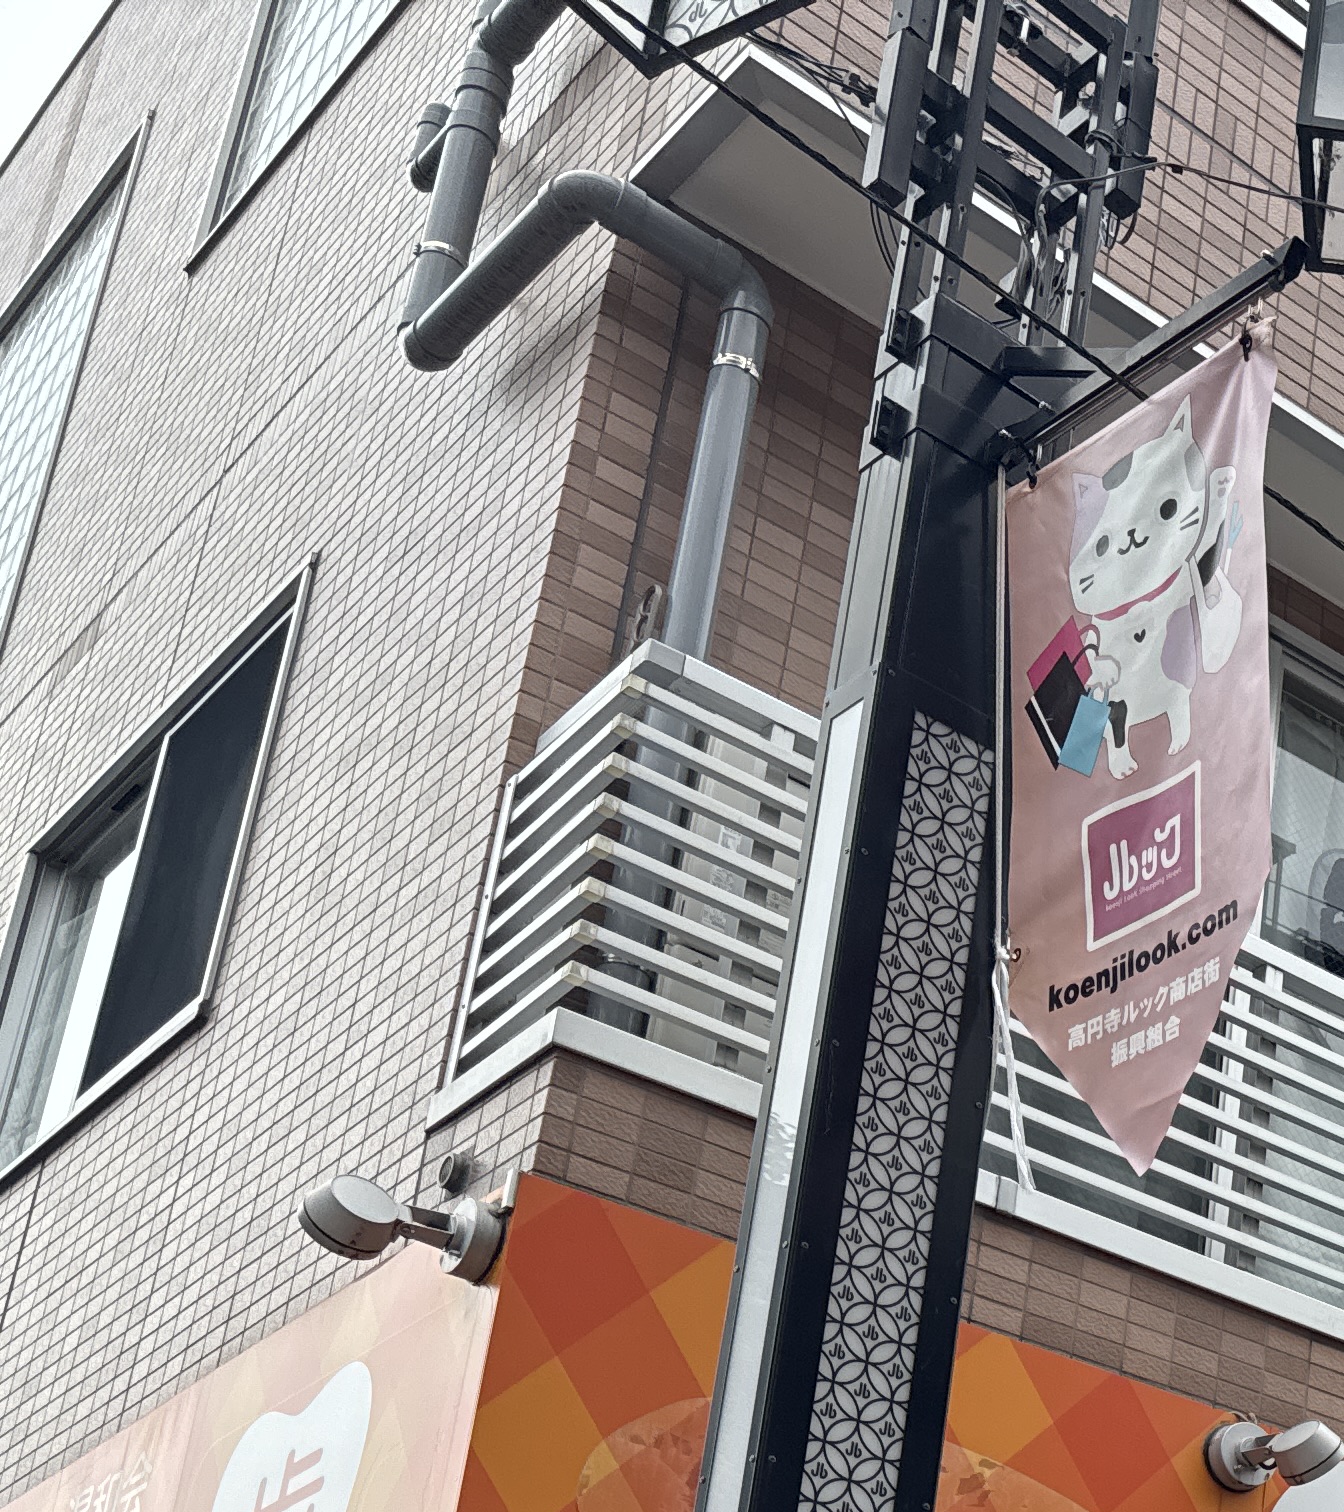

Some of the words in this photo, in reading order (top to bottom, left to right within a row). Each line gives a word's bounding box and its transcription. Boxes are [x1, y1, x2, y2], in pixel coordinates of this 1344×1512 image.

[1048, 900, 1238, 1012] koenjilook.com
[1067, 957, 1220, 1051] 高円寺ルック商店街
[1111, 1015, 1181, 1068] 振興組合
